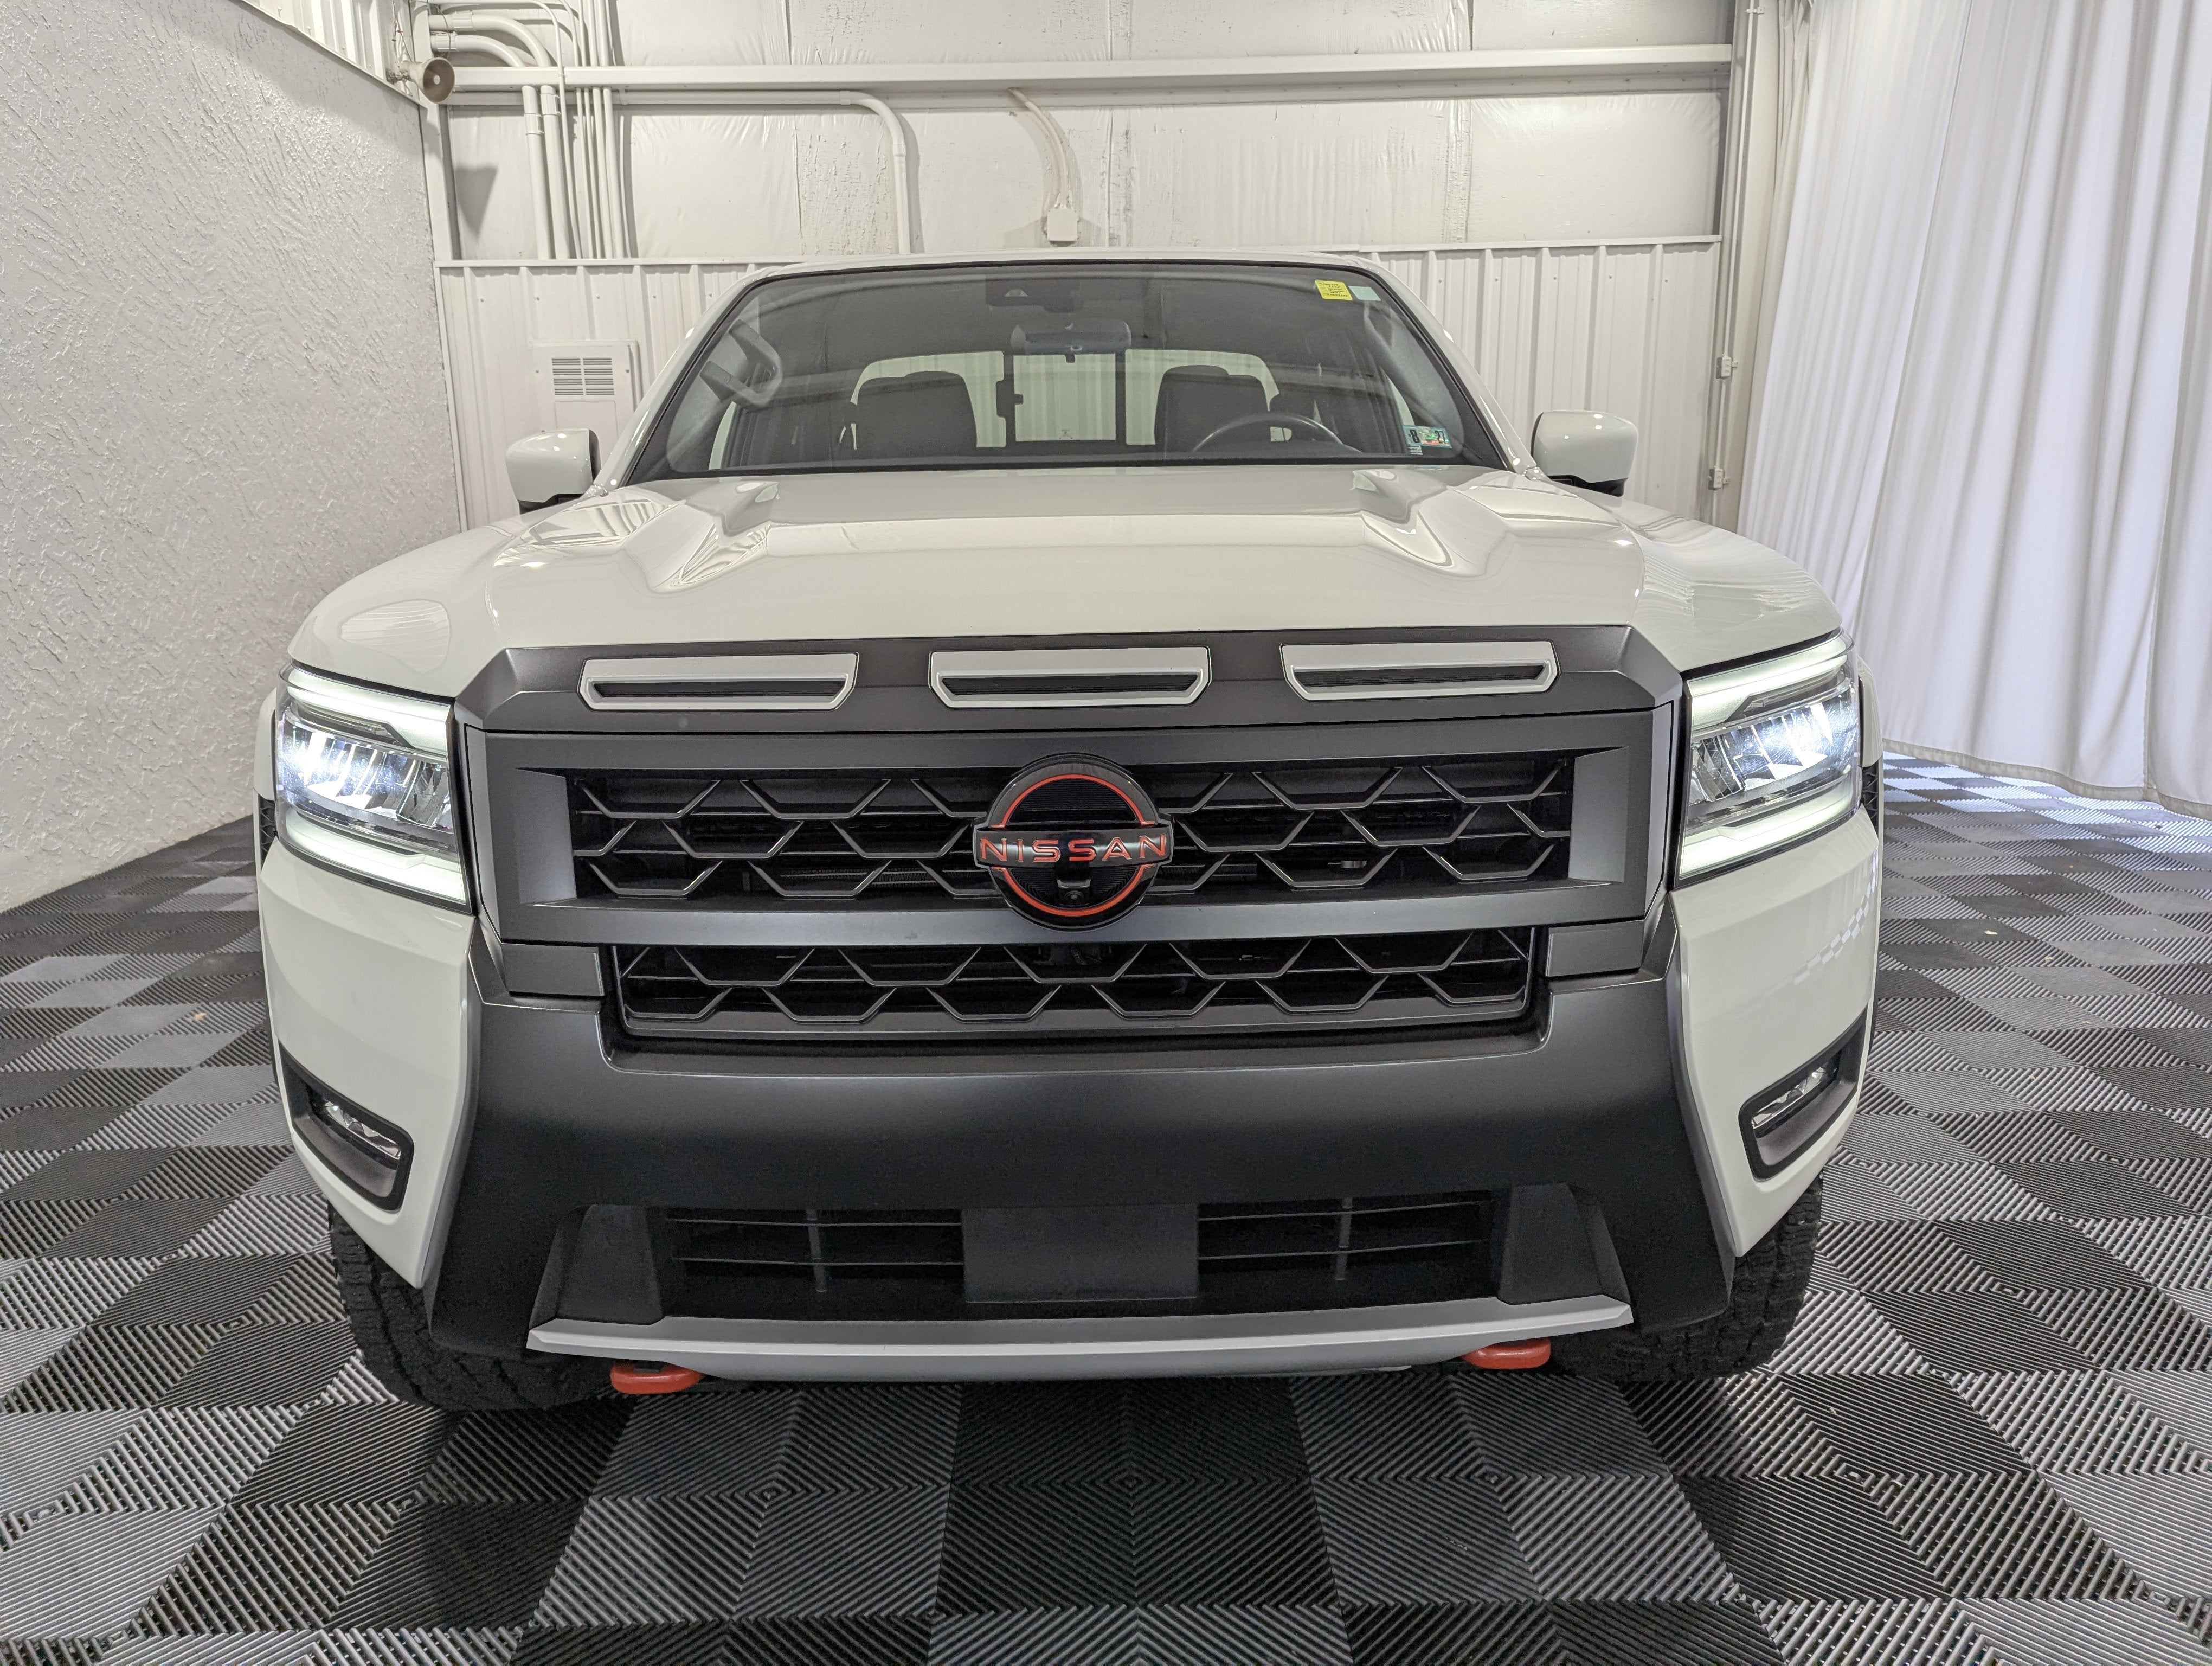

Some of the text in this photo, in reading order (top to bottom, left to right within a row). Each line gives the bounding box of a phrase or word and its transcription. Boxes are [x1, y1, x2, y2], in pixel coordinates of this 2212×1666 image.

[1410, 429, 1446, 444] 8 27
[980, 834, 1166, 862] NISSAN
